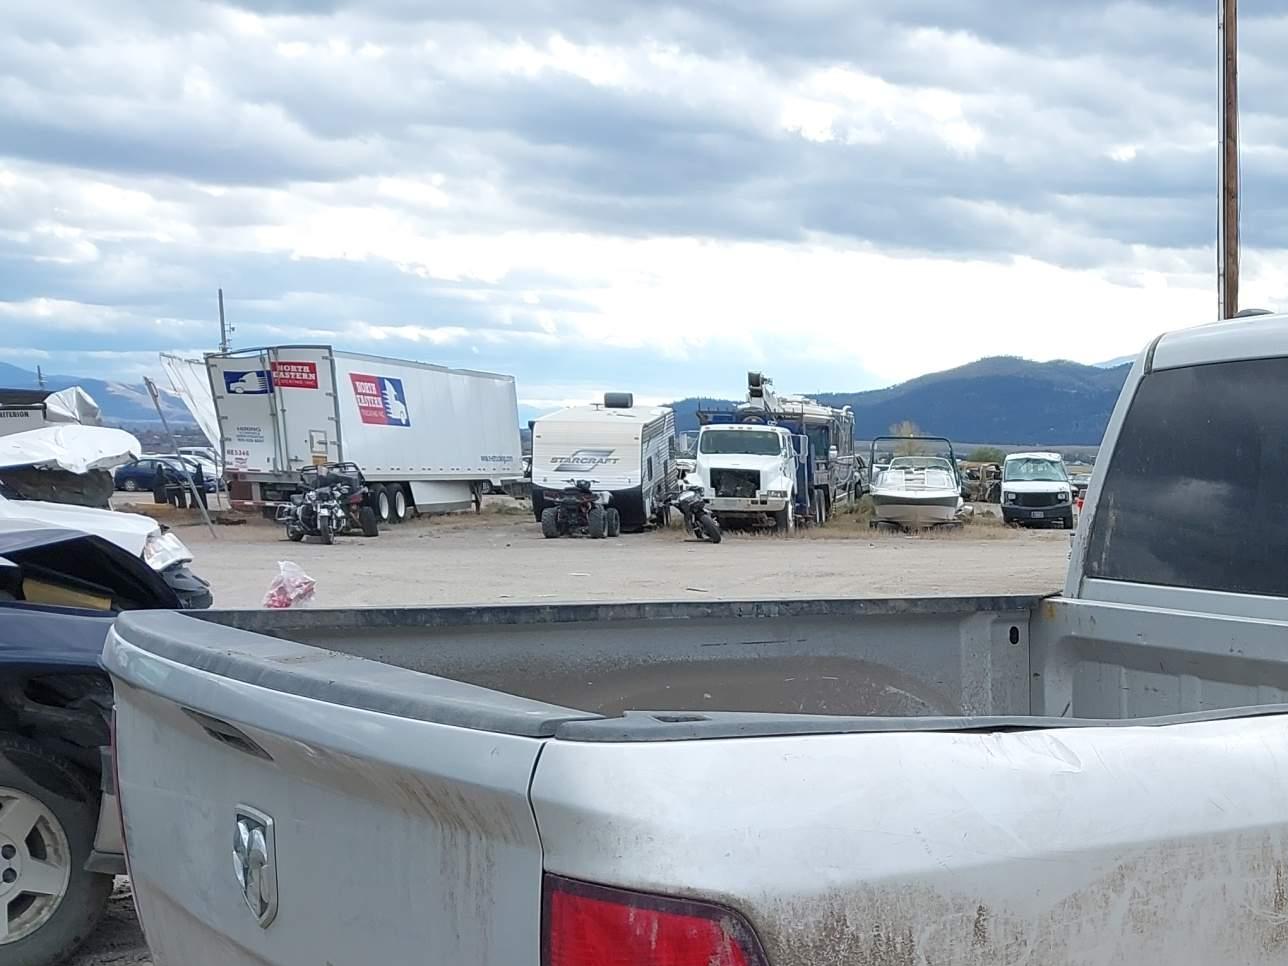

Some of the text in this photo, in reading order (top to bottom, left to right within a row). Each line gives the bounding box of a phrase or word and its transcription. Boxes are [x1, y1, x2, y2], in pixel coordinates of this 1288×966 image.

[277, 365, 309, 373] NORTH
[273, 371, 315, 380] EASTERN
[354, 381, 377, 394] NORTH
[356, 394, 384, 408] EASTERN
